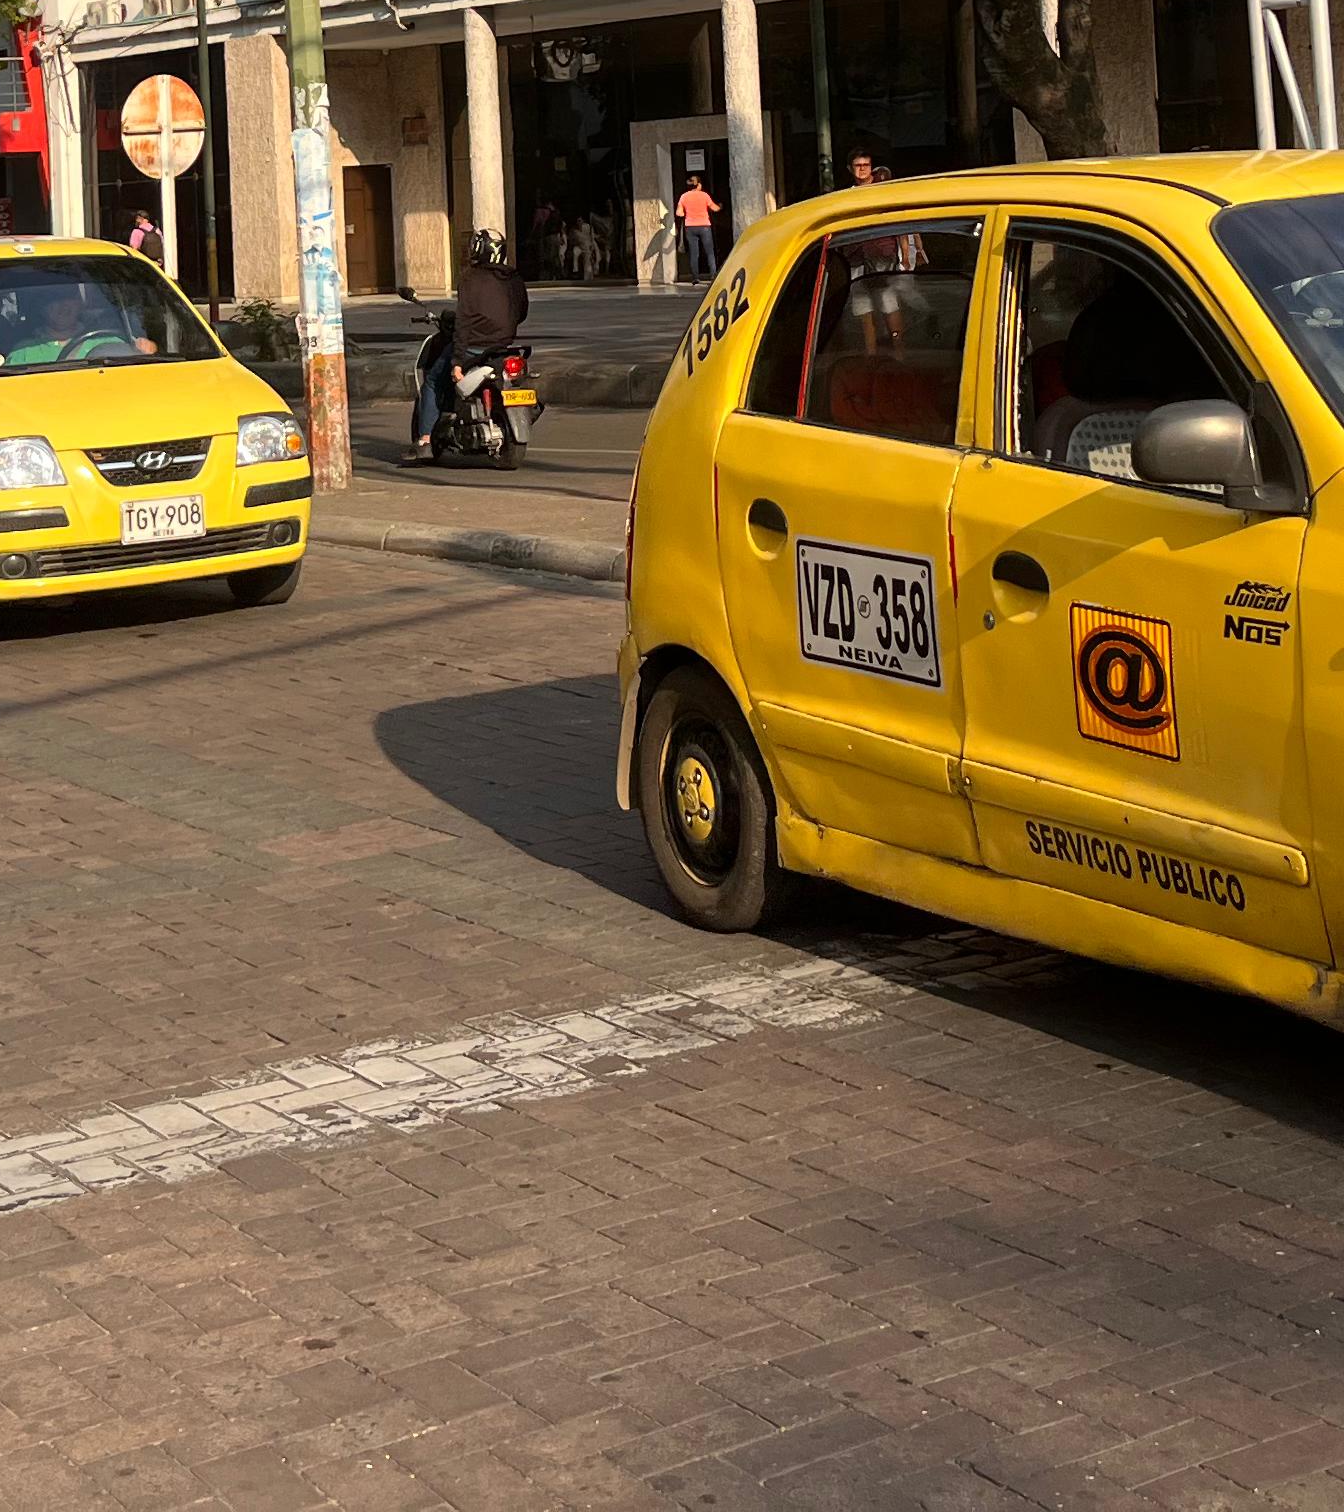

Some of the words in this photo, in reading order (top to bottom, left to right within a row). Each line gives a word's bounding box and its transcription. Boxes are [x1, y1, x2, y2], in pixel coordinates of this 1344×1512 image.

[682, 267, 750, 378] 1582
[125, 506, 160, 532] TGY
[165, 502, 201, 528] 908
[802, 560, 856, 643] VZD
[872, 573, 930, 659] 358
[838, 644, 903, 671] NEIVA
[1025, 819, 1133, 880] SERVICIO
[1135, 848, 1246, 912] PUBLICO
